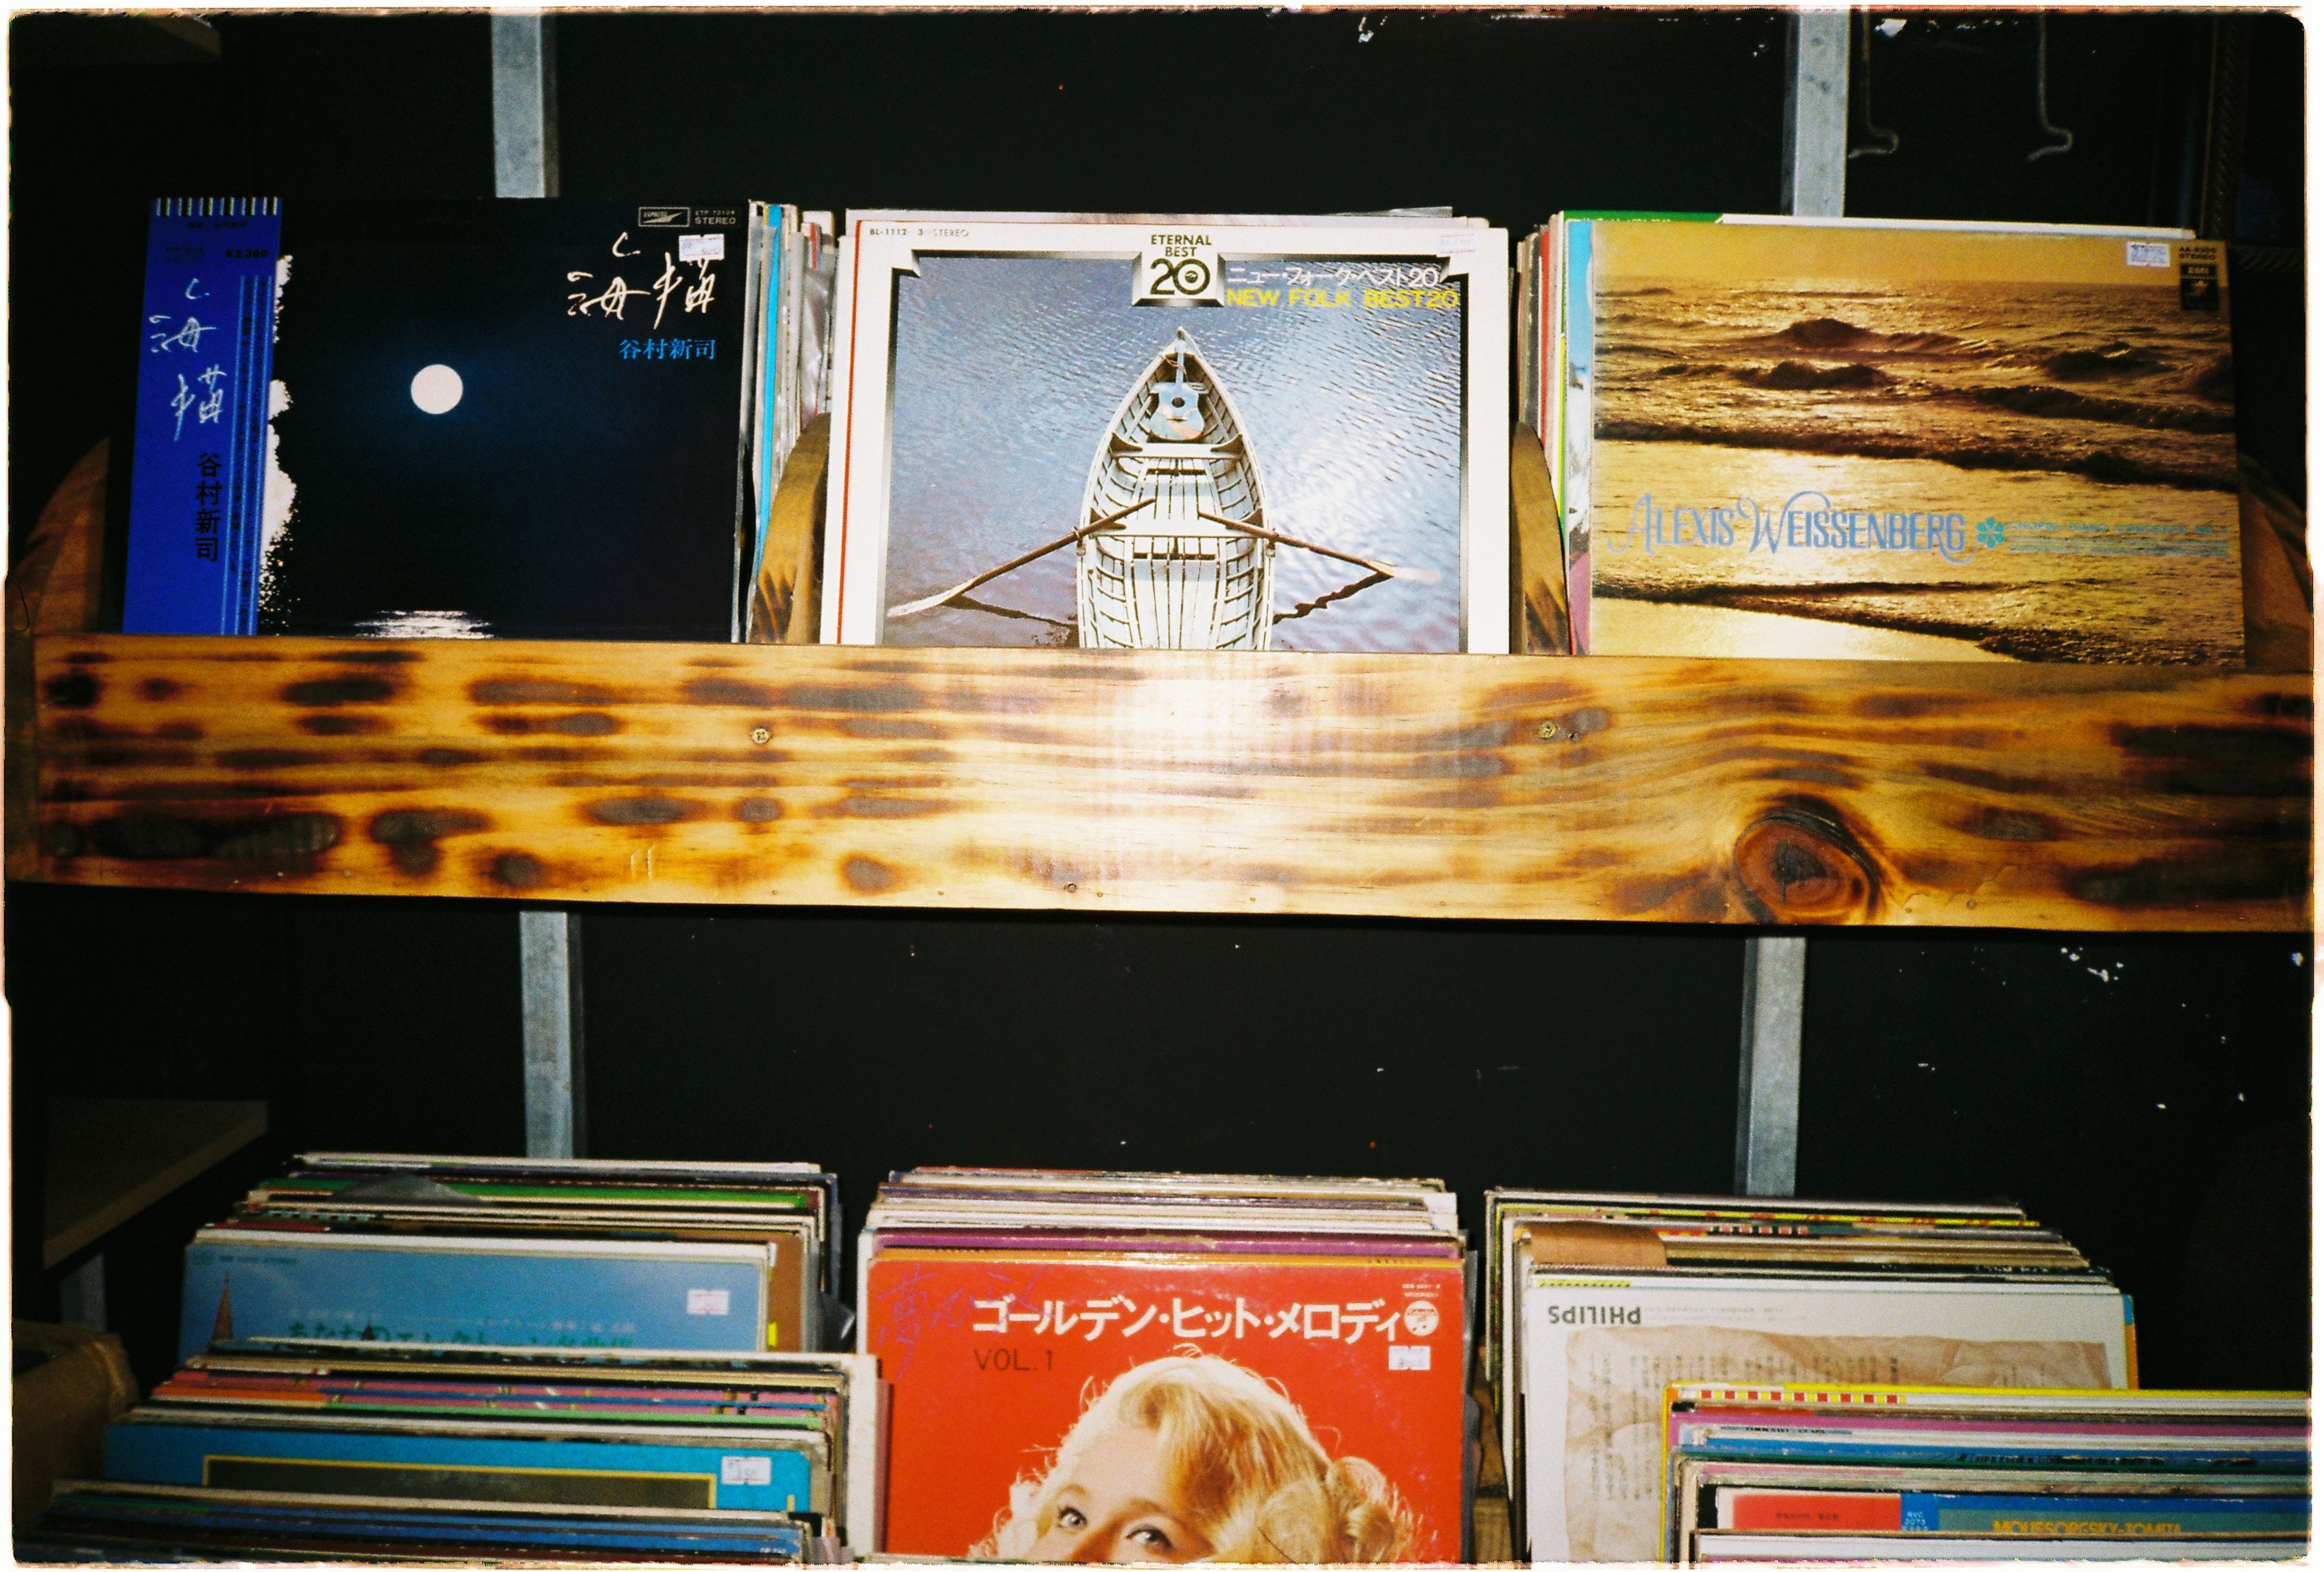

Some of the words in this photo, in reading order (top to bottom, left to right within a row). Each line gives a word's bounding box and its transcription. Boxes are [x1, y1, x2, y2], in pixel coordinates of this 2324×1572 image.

[1151, 234, 1212, 245] ETERNAL
[1165, 246, 1197, 257] BEST
[1149, 258, 1211, 295] 20
[1227, 288, 1280, 307] NEW
[1288, 289, 1351, 307] FOLK
[619, 338, 717, 361] 谷村新司
[195, 451, 223, 563] 谷村新司
[1607, 493, 1736, 555] ALEXIS
[1736, 490, 1975, 566] WEISSENBERG
[972, 1294, 1401, 1344] ゴールデン・ヒット・メロディ
[1547, 1305, 1643, 1325] PHILIPS
